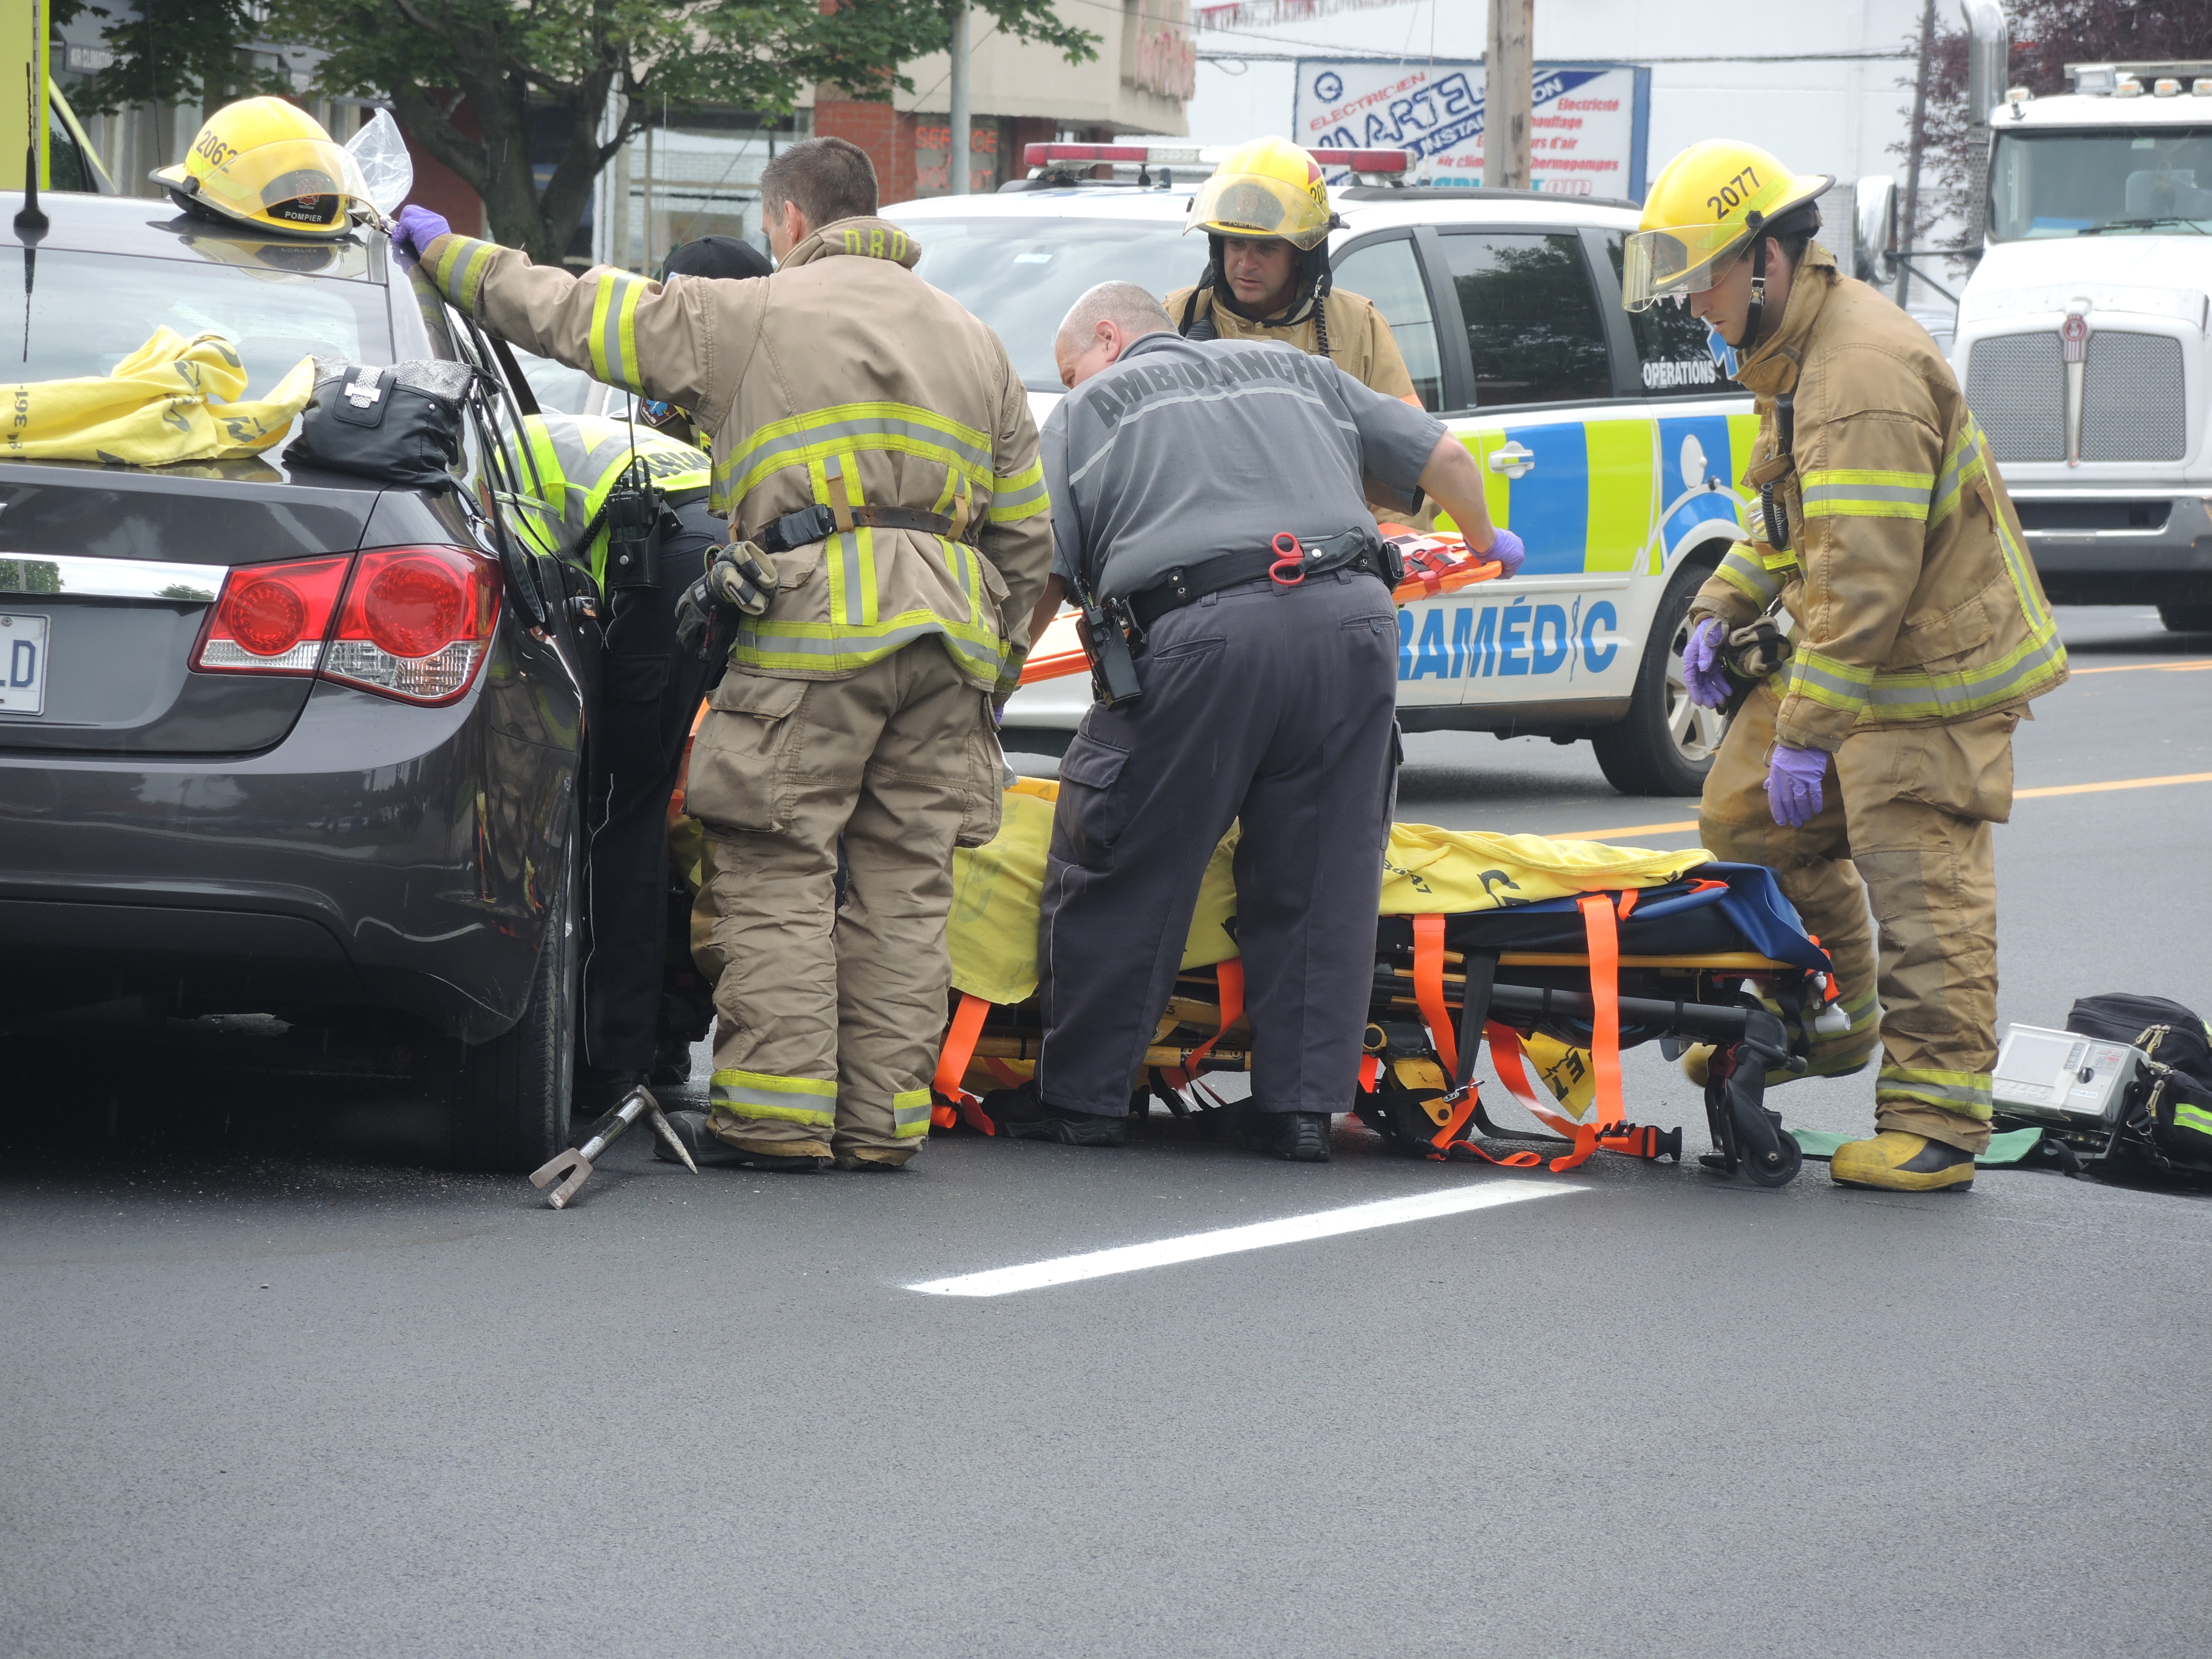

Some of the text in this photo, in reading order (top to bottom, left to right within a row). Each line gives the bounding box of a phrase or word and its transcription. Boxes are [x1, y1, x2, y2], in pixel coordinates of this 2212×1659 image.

[1530, 116, 1583, 131] hauffage
[196, 130, 238, 175] 2062
[915, 127, 997, 153] SERCE
[1530, 156, 1619, 172] hermopompes
[1310, 181, 1327, 208] 203
[1707, 166, 1760, 220] 2077
[285, 211, 322, 222] POMPIER
[1643, 356, 1716, 387] OPÉRATIONS
[1088, 349, 1315, 430] AMBULANCE
